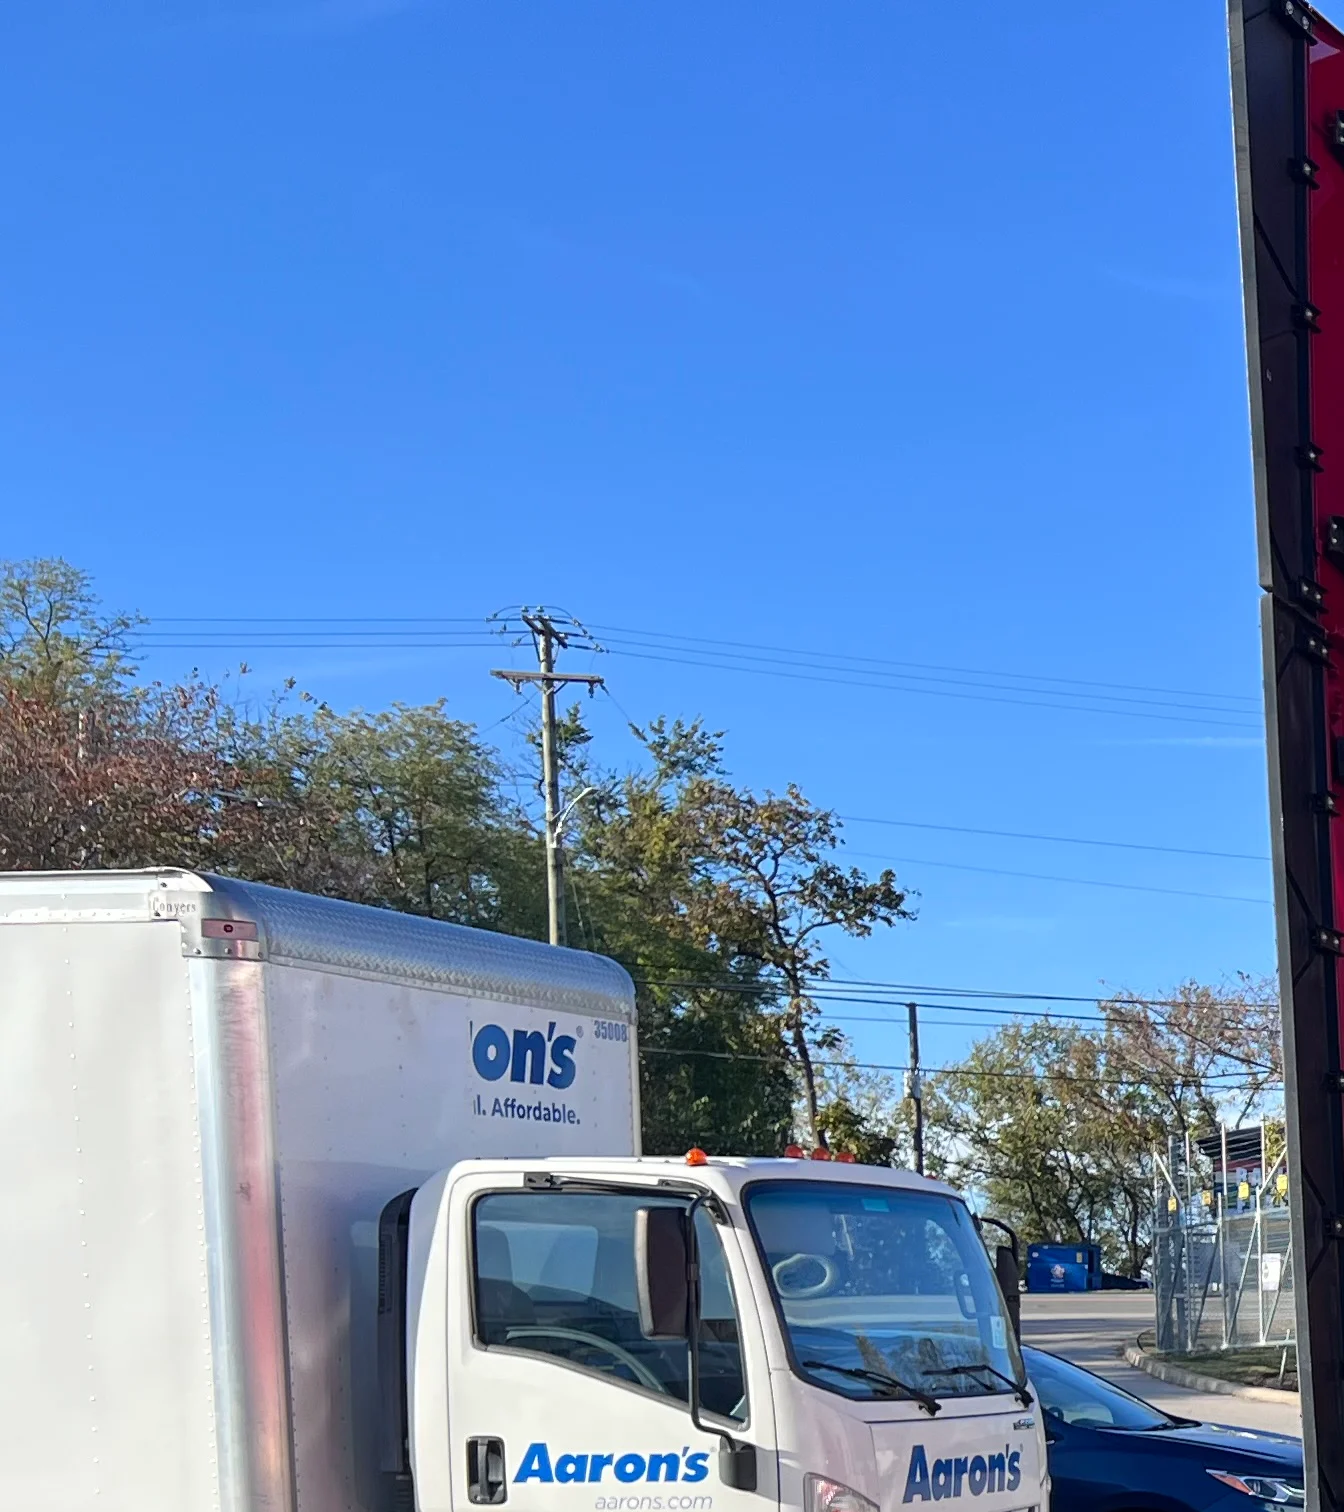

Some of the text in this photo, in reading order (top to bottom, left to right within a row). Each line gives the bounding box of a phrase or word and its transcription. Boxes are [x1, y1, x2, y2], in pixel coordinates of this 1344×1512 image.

[593, 1019, 628, 1043] 35008
[491, 1097, 581, 1125] Affordable.
[512, 1442, 710, 1484] Aaron's
[902, 1443, 1021, 1505] Aaron's
[594, 1495, 713, 1511] aarons.com
